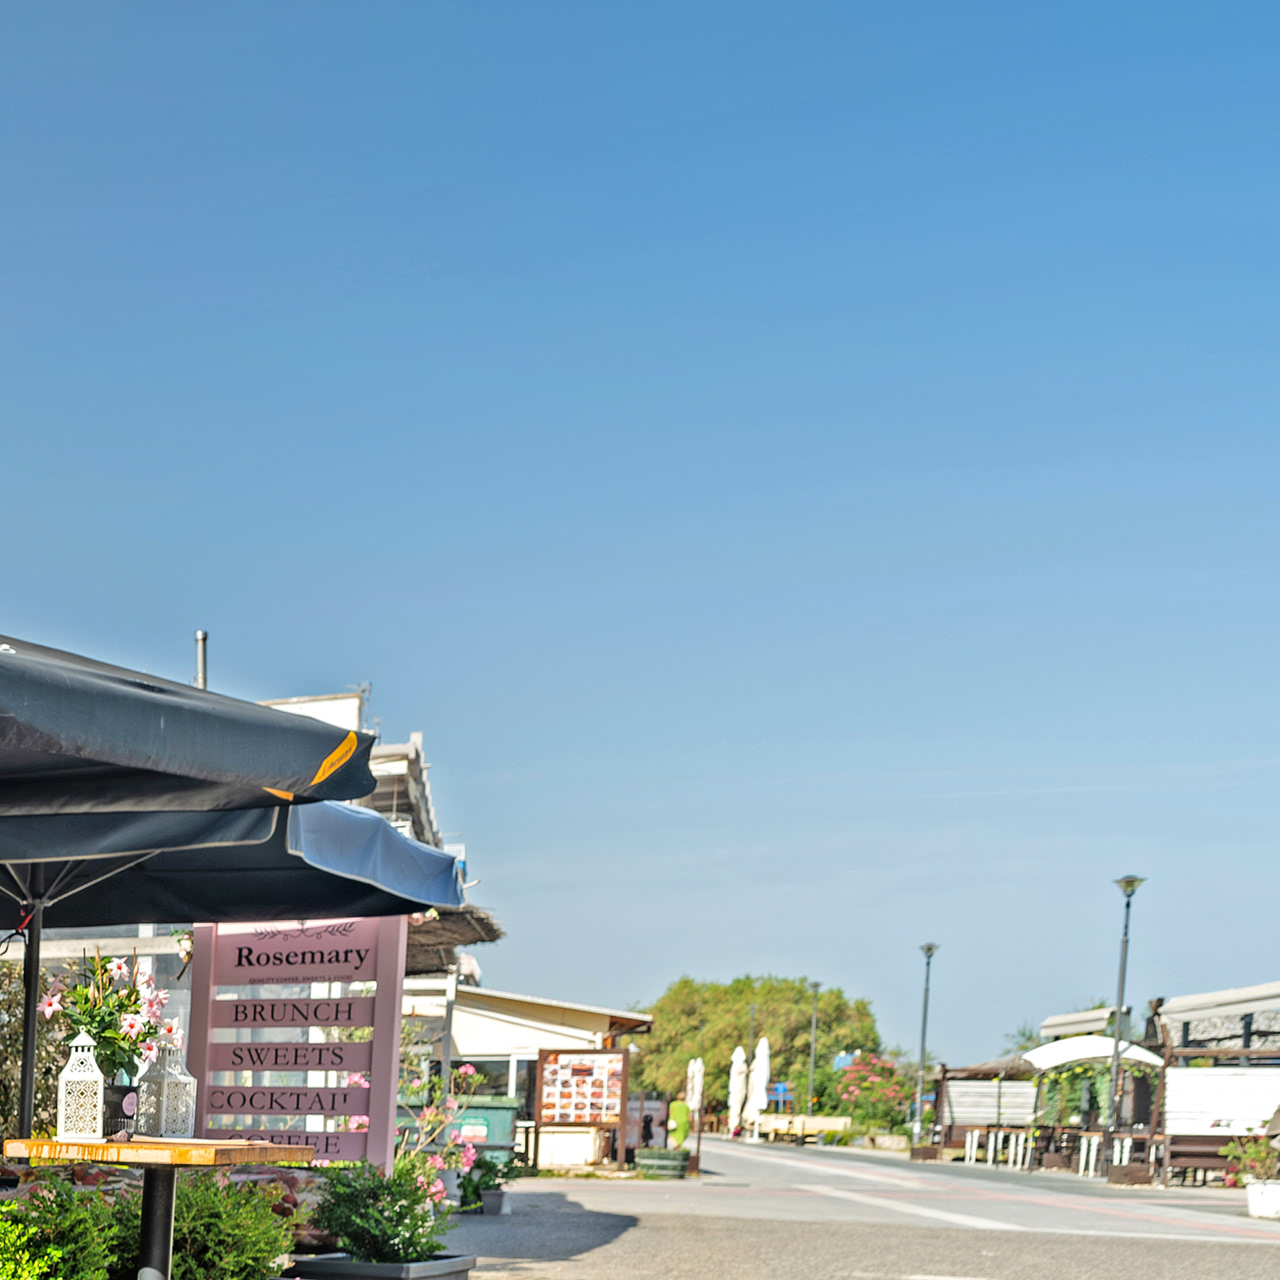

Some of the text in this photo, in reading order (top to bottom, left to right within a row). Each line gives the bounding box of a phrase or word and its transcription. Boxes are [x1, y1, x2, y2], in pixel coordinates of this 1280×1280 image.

[235, 946, 370, 970] Rosemary
[233, 1002, 354, 1022] BRUNCH
[231, 1046, 344, 1066] SWEETS
